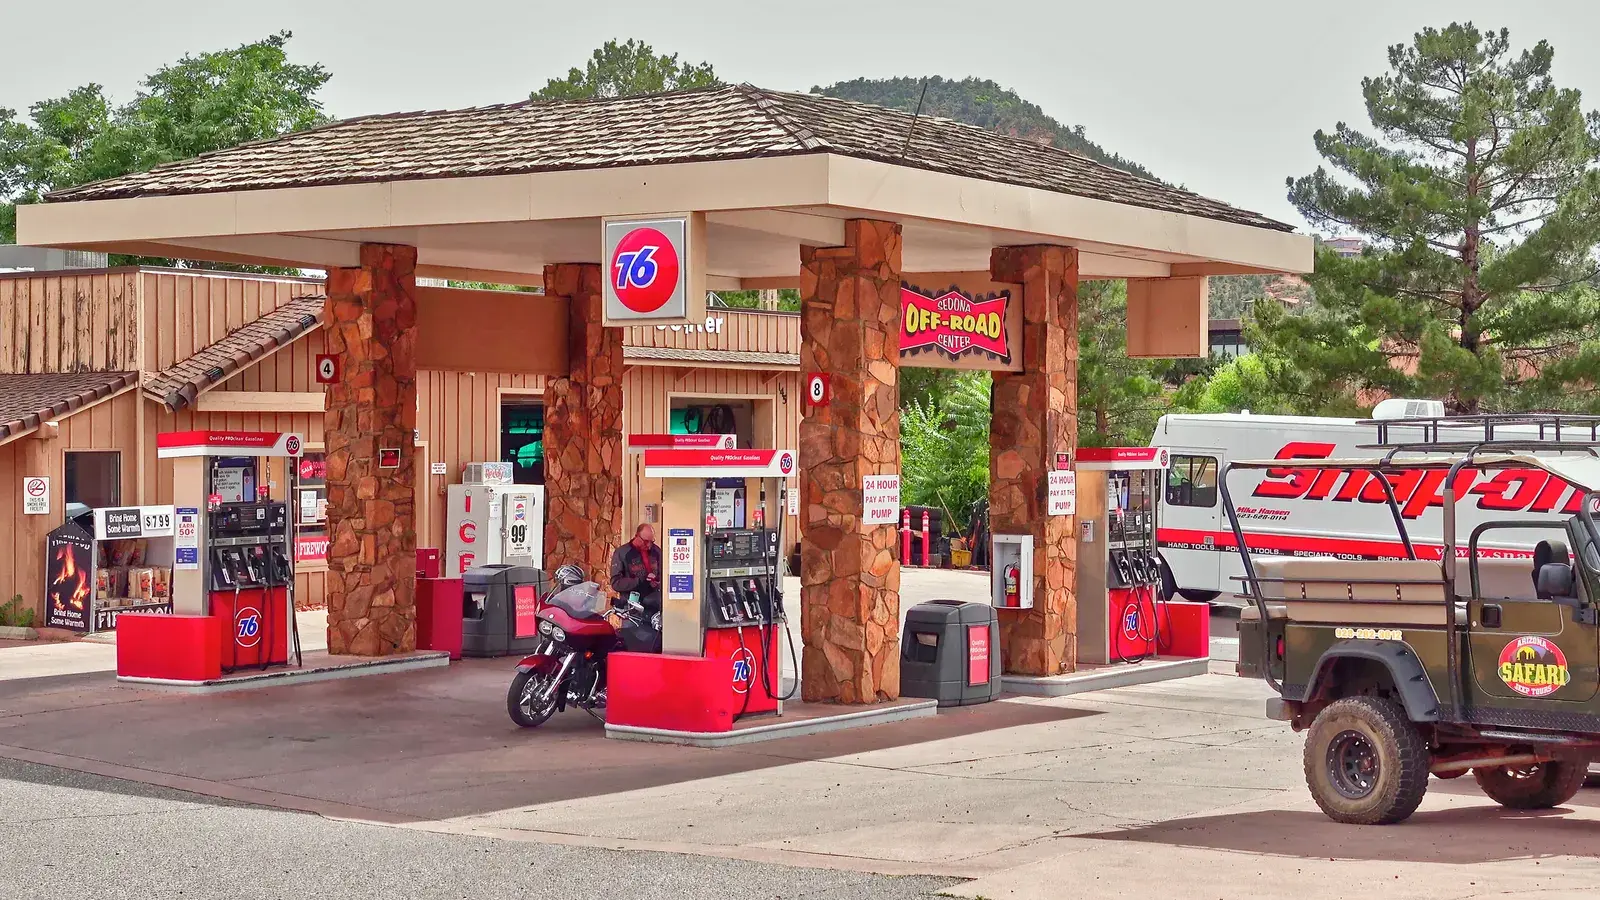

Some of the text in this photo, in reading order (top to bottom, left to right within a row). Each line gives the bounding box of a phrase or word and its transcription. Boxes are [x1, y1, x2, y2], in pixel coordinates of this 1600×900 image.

[615, 246, 660, 290] 76
[937, 298, 971, 312] SEDONA
[906, 303, 1001, 339] OFF-ROAD
[937, 333, 971, 348] CENTER
[323, 362, 332, 375] 4
[813, 382, 821, 396] 8
[287, 438, 299, 450] 76
[781, 457, 791, 469] 76
[301, 465, 313, 475] SALE
[865, 480, 898, 490] 24 HOUR
[1050, 475, 1074, 485] 24 HOUR
[1252, 441, 1586, 519] Snap-on
[1050, 489, 1060, 497] PAY
[1067, 488, 1075, 496] THE
[865, 496, 877, 504] PAY
[887, 495, 898, 503] THE
[1055, 501, 1071, 510] PUMP
[279, 507, 285, 515] 4
[871, 509, 893, 519] PUMP
[1258, 508, 1290, 516] Hansen
[109, 513, 137, 523] Bring Home
[107, 523, 141, 534] Some Warmth
[771, 532, 777, 543] 8
[673, 552, 690, 561] 50¢
[1225, 545, 1252, 553] POWR
[1293, 550, 1335, 558] SPECIALTY
[53, 608, 82, 619] Bring Home
[51, 616, 85, 628] Some Warmth
[238, 614, 259, 637] 76
[1517, 636, 1548, 650] ARIZONA
[732, 656, 752, 682] 76
[1502, 661, 1567, 686] SAFARI
[1514, 683, 1553, 696] JEEP TOURS
